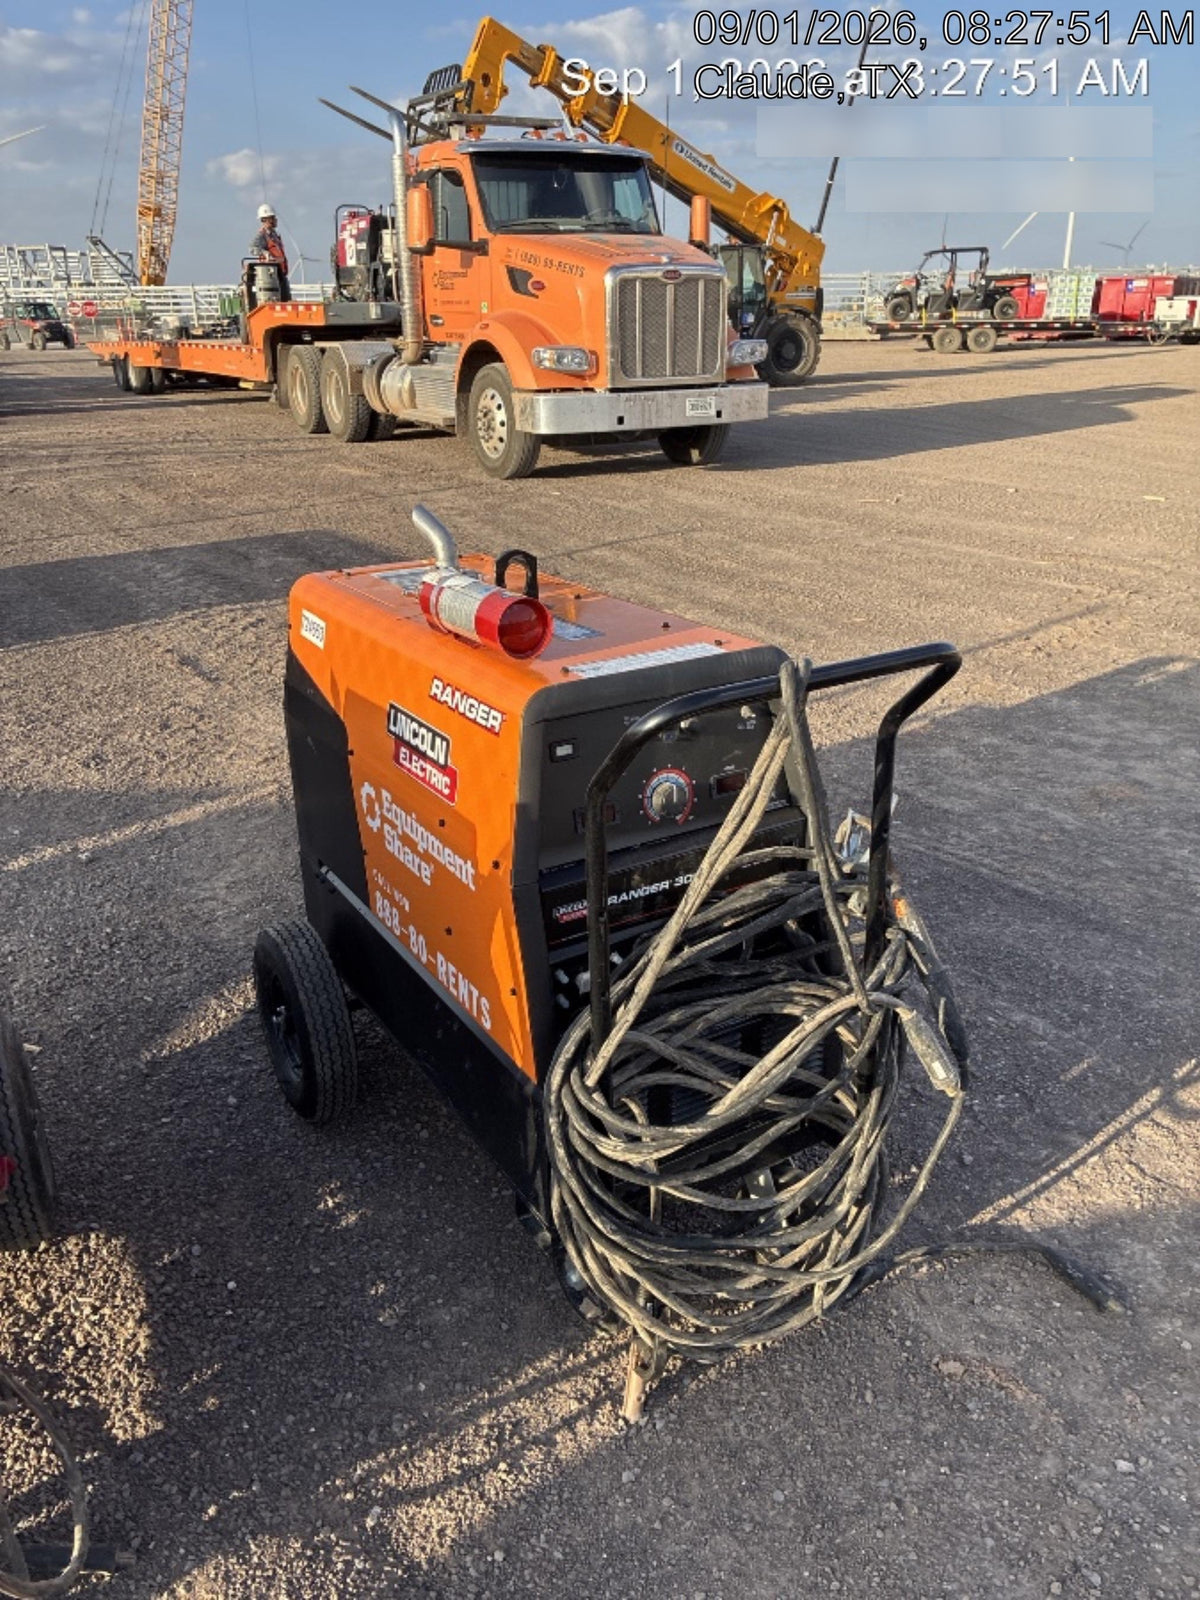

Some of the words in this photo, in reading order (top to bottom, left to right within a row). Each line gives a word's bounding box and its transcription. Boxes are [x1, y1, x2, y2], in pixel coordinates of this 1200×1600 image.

[429, 677, 502, 734] RANGER
[388, 708, 448, 766] LINCOLN
[399, 747, 451, 796] ELECTRIC
[380, 788, 476, 891] Equipment
[383, 821, 432, 887] Share
[607, 881, 670, 906] RANGER
[375, 890, 492, 1031] 888-80-RENTS
